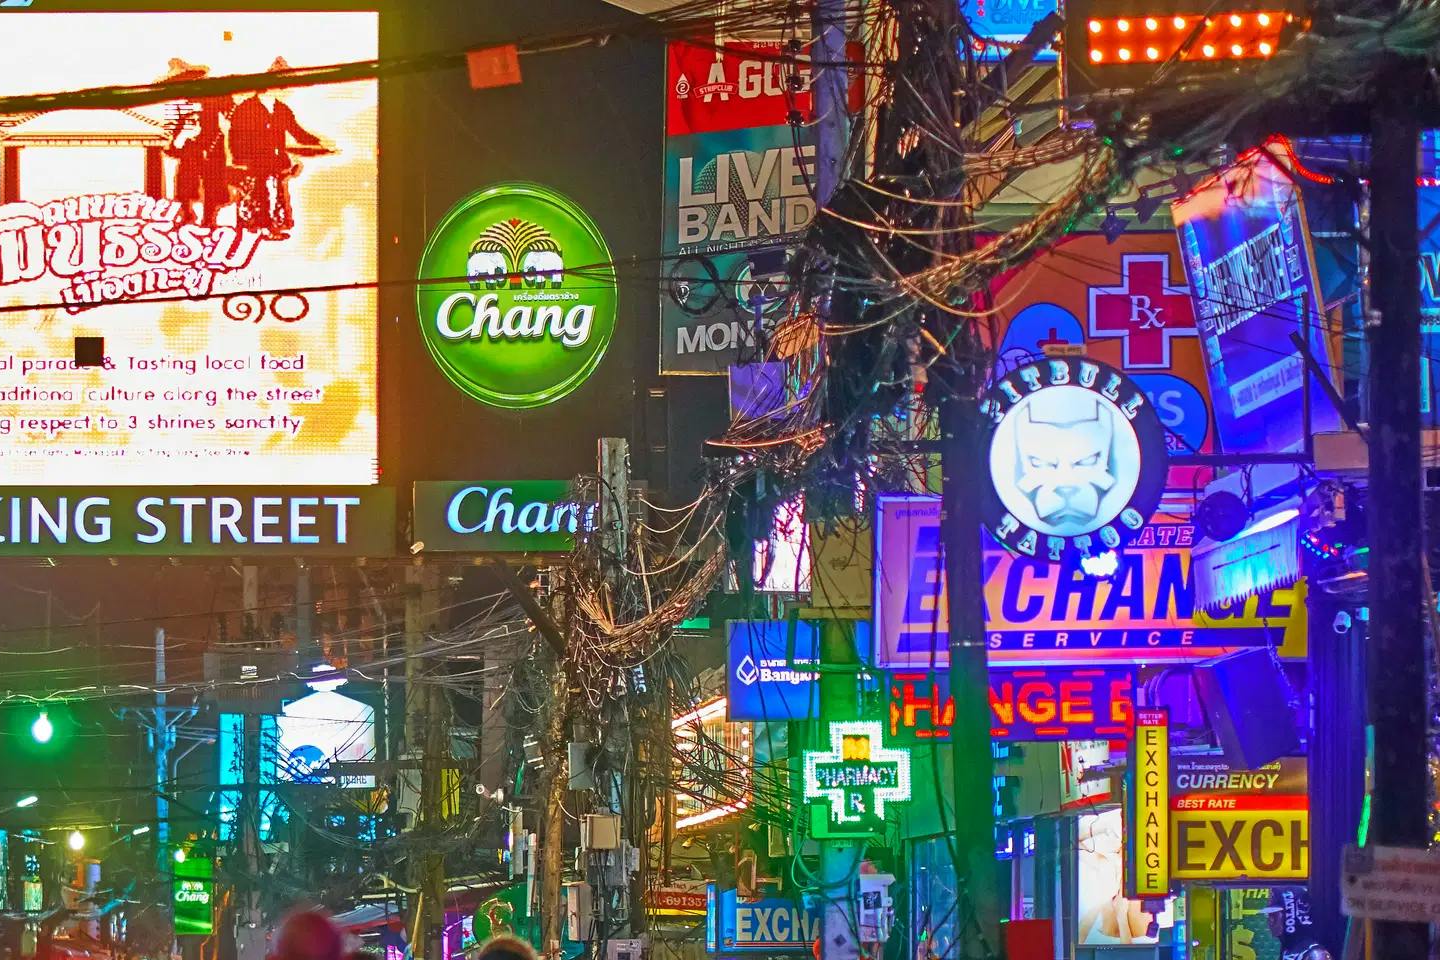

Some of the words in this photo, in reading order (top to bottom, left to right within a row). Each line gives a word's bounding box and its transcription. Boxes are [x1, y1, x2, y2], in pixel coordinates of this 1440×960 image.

[678, 145, 817, 207] LIVE
[678, 196, 817, 244] BAND
[436, 292, 596, 347] Chang
[128, 356, 196, 375] Tasting
[261, 356, 304, 370] food
[88, 387, 155, 401] culture
[163, 388, 217, 406] along
[226, 387, 257, 401] the
[266, 387, 322, 401] street
[20, 416, 91, 433] respect
[100, 416, 118, 429] to
[128, 416, 137, 429] 3
[148, 416, 216, 429] shrines
[224, 416, 301, 433] sanctity
[136, 495, 360, 544] STREET
[995, 508, 1144, 560] TATTOO
[989, 630, 1195, 648] SERVICE
[815, 768, 899, 787] PHARMACY
[1176, 774, 1280, 789] CURRENCY
[1144, 729, 1160, 889] EXCHANGE
[1177, 799, 1205, 808] BEST
[1208, 799, 1236, 808] RATE
[175, 891, 209, 903] Chang
